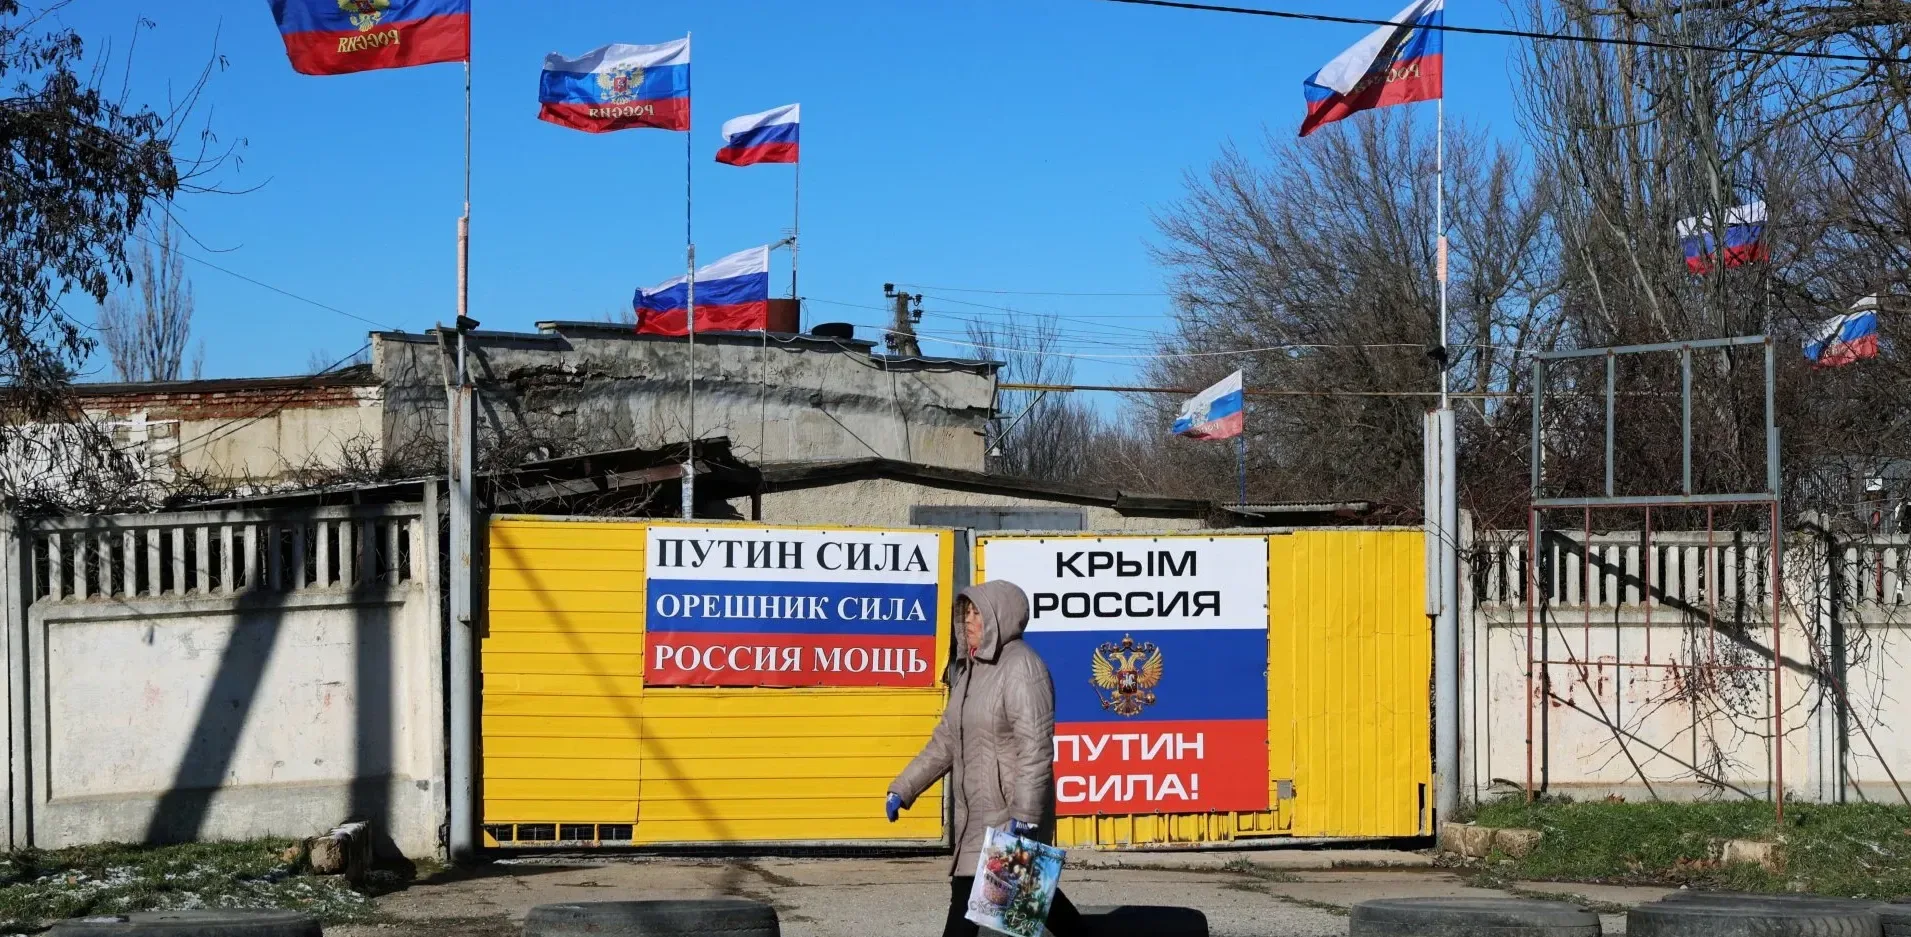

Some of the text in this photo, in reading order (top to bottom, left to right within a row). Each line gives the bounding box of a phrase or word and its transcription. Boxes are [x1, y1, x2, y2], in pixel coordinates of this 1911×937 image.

[656, 538, 930, 572] ПУТИН СИЛА
[1056, 550, 1197, 577] КРЫМ
[656, 594, 927, 621] ОРЕШНИК СИЛА
[1033, 590, 1221, 619] РОССИЯ
[653, 644, 928, 678] РОССИЯ МОЩЬ
[1053, 732, 1204, 762] ПУТИН
[1056, 773, 1199, 803] СИЛА!
